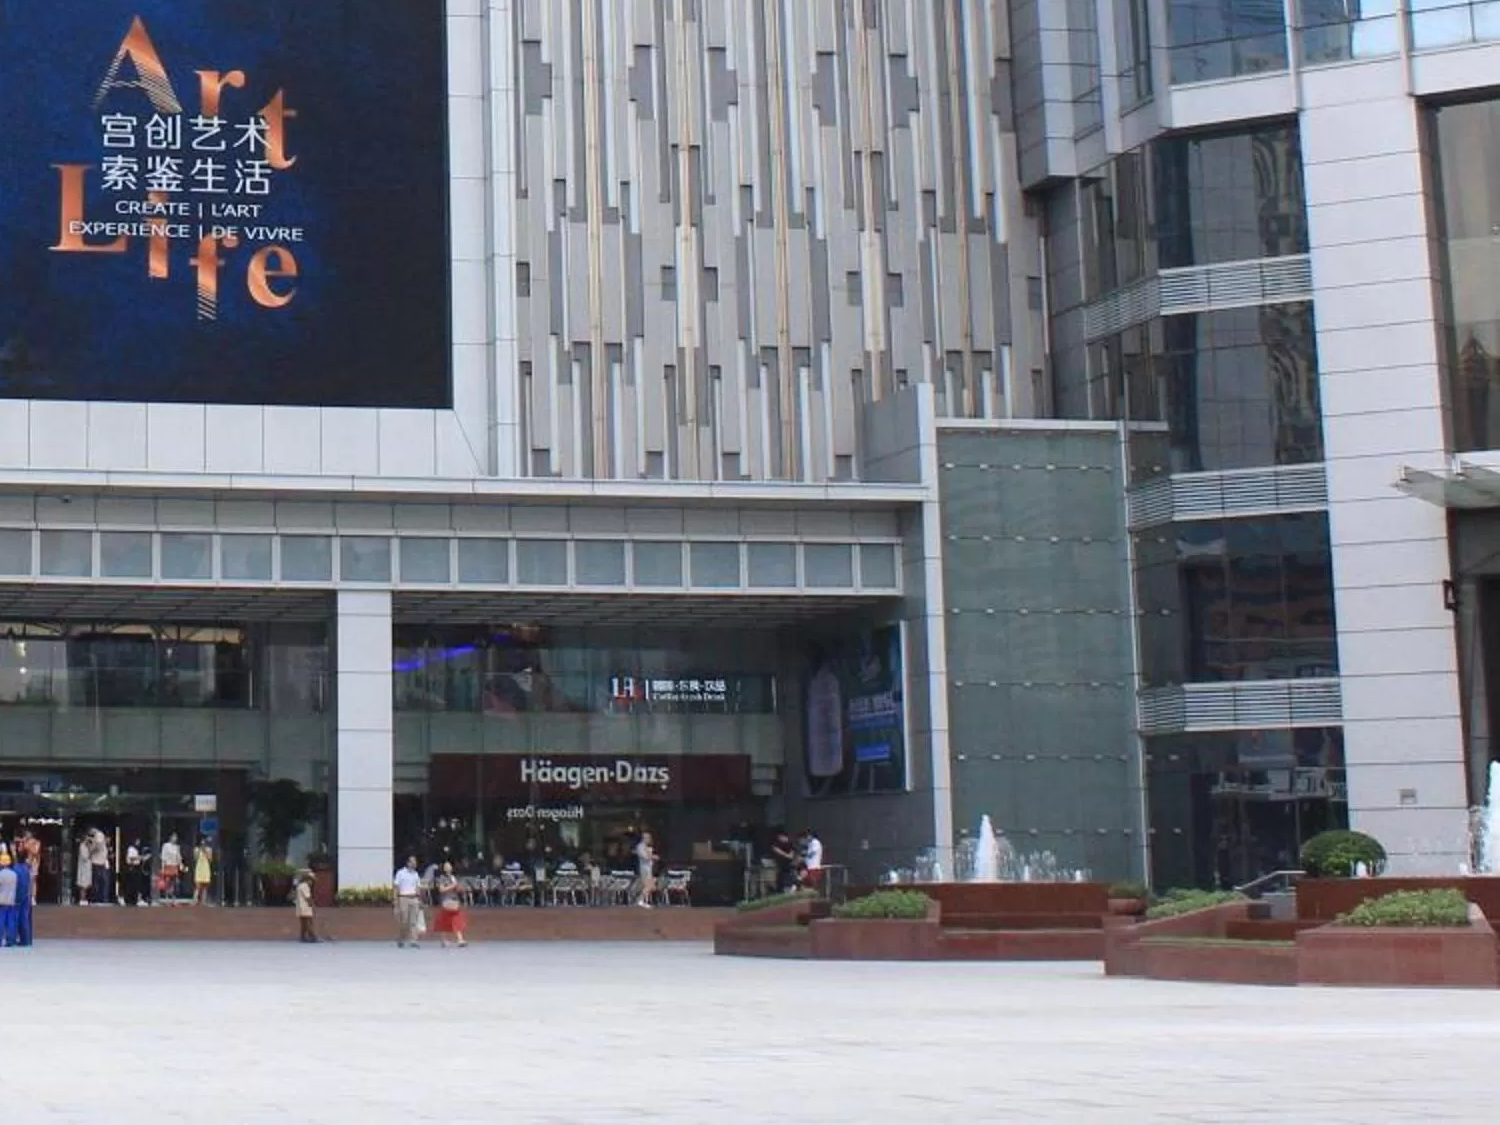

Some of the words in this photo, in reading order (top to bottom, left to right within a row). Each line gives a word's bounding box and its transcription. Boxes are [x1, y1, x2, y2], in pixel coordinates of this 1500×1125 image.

[100, 112, 273, 153] 宫创艺术
[100, 155, 273, 196] 索鉴生活
[114, 200, 191, 217] CREATE
[68, 221, 191, 239] EXPERIENCE
[211, 225, 239, 241] DE
[243, 225, 304, 242] VIVRE
